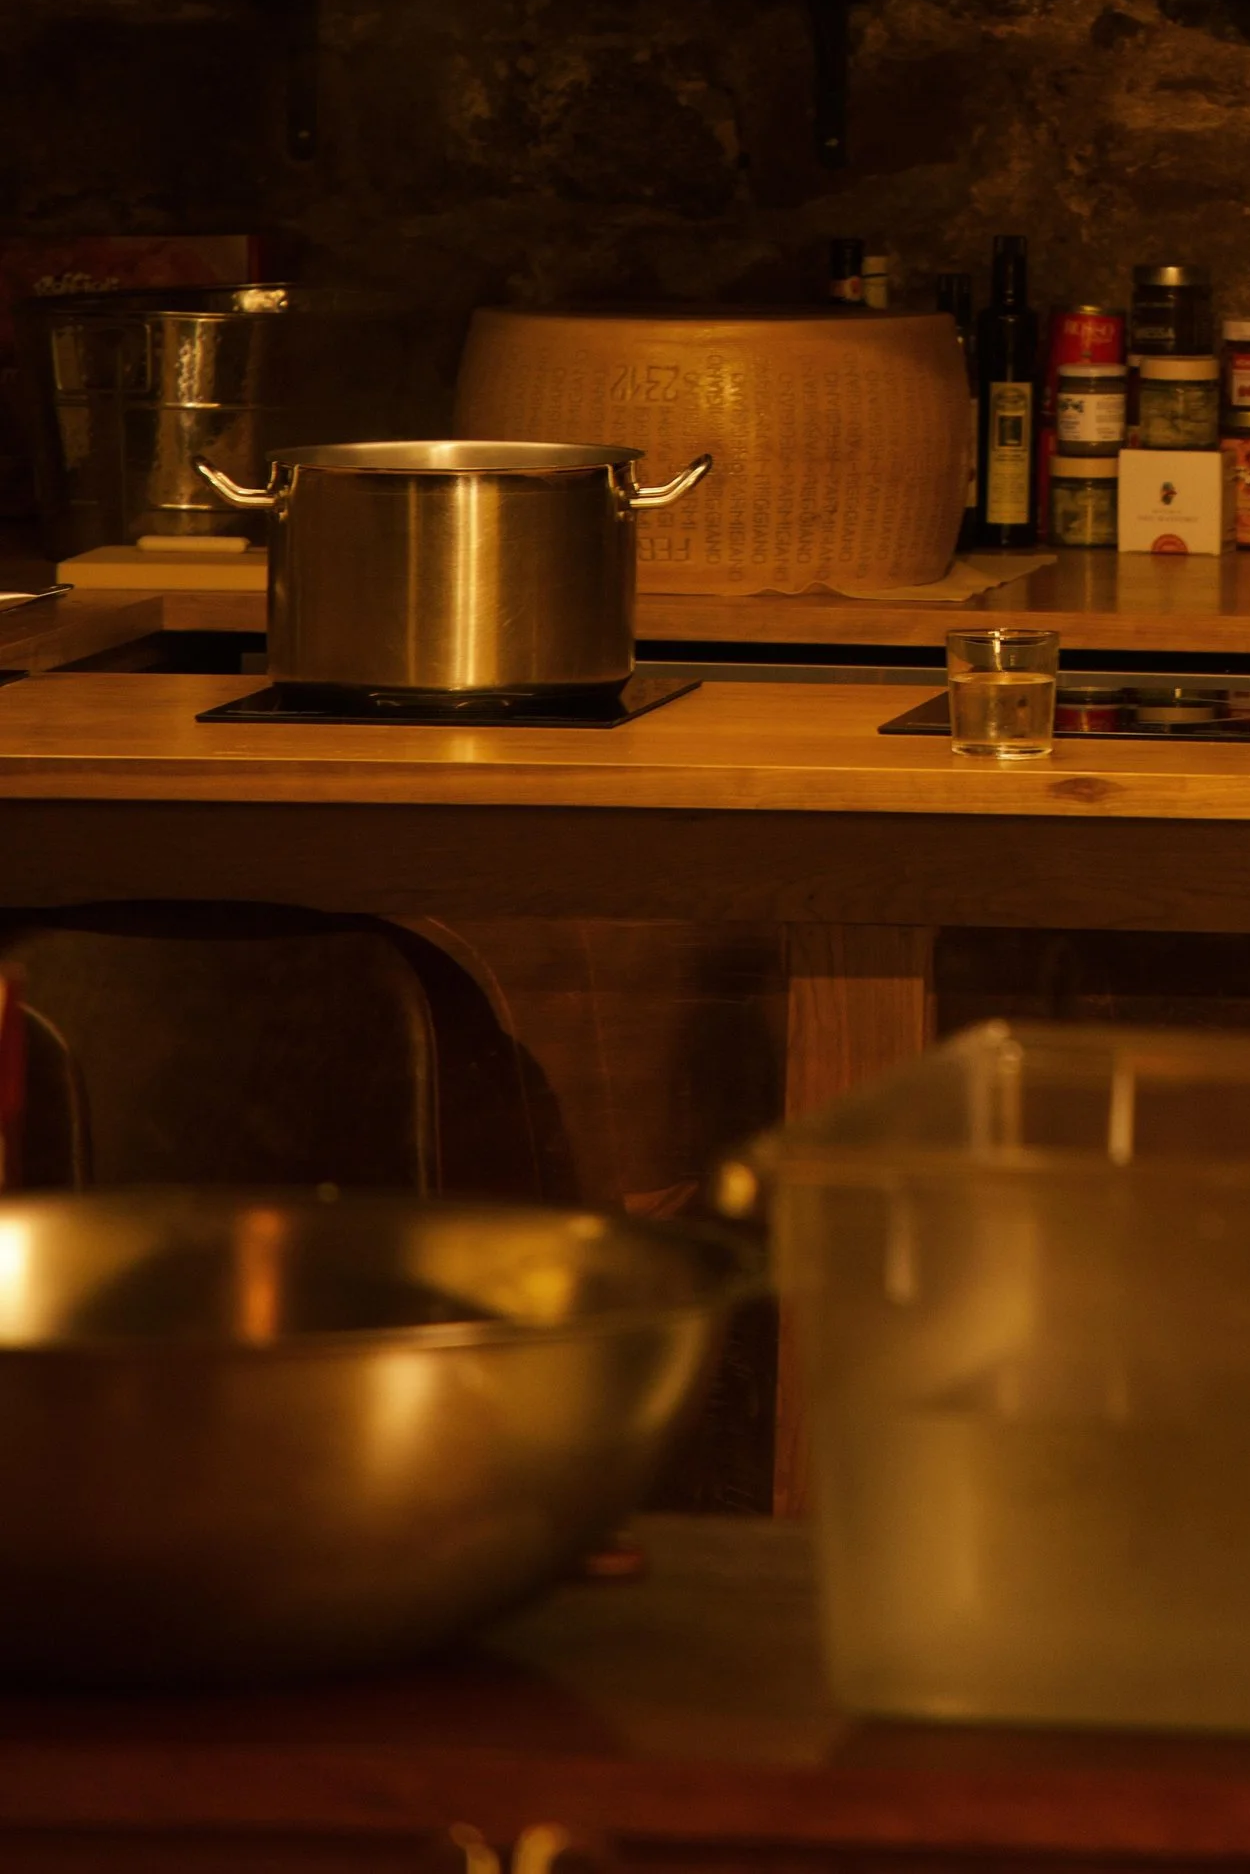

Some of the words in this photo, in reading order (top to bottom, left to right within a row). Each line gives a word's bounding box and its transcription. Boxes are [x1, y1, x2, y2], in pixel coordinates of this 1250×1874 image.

[704, 474, 724, 566] REGGIANO
[727, 474, 747, 582] PARMIGIANO
[750, 474, 772, 566] REGGIANO
[773, 474, 796, 582] PARMIGIANO
[796, 473, 818, 565] REGGIANO
[838, 472, 860, 564] REGGIANO
